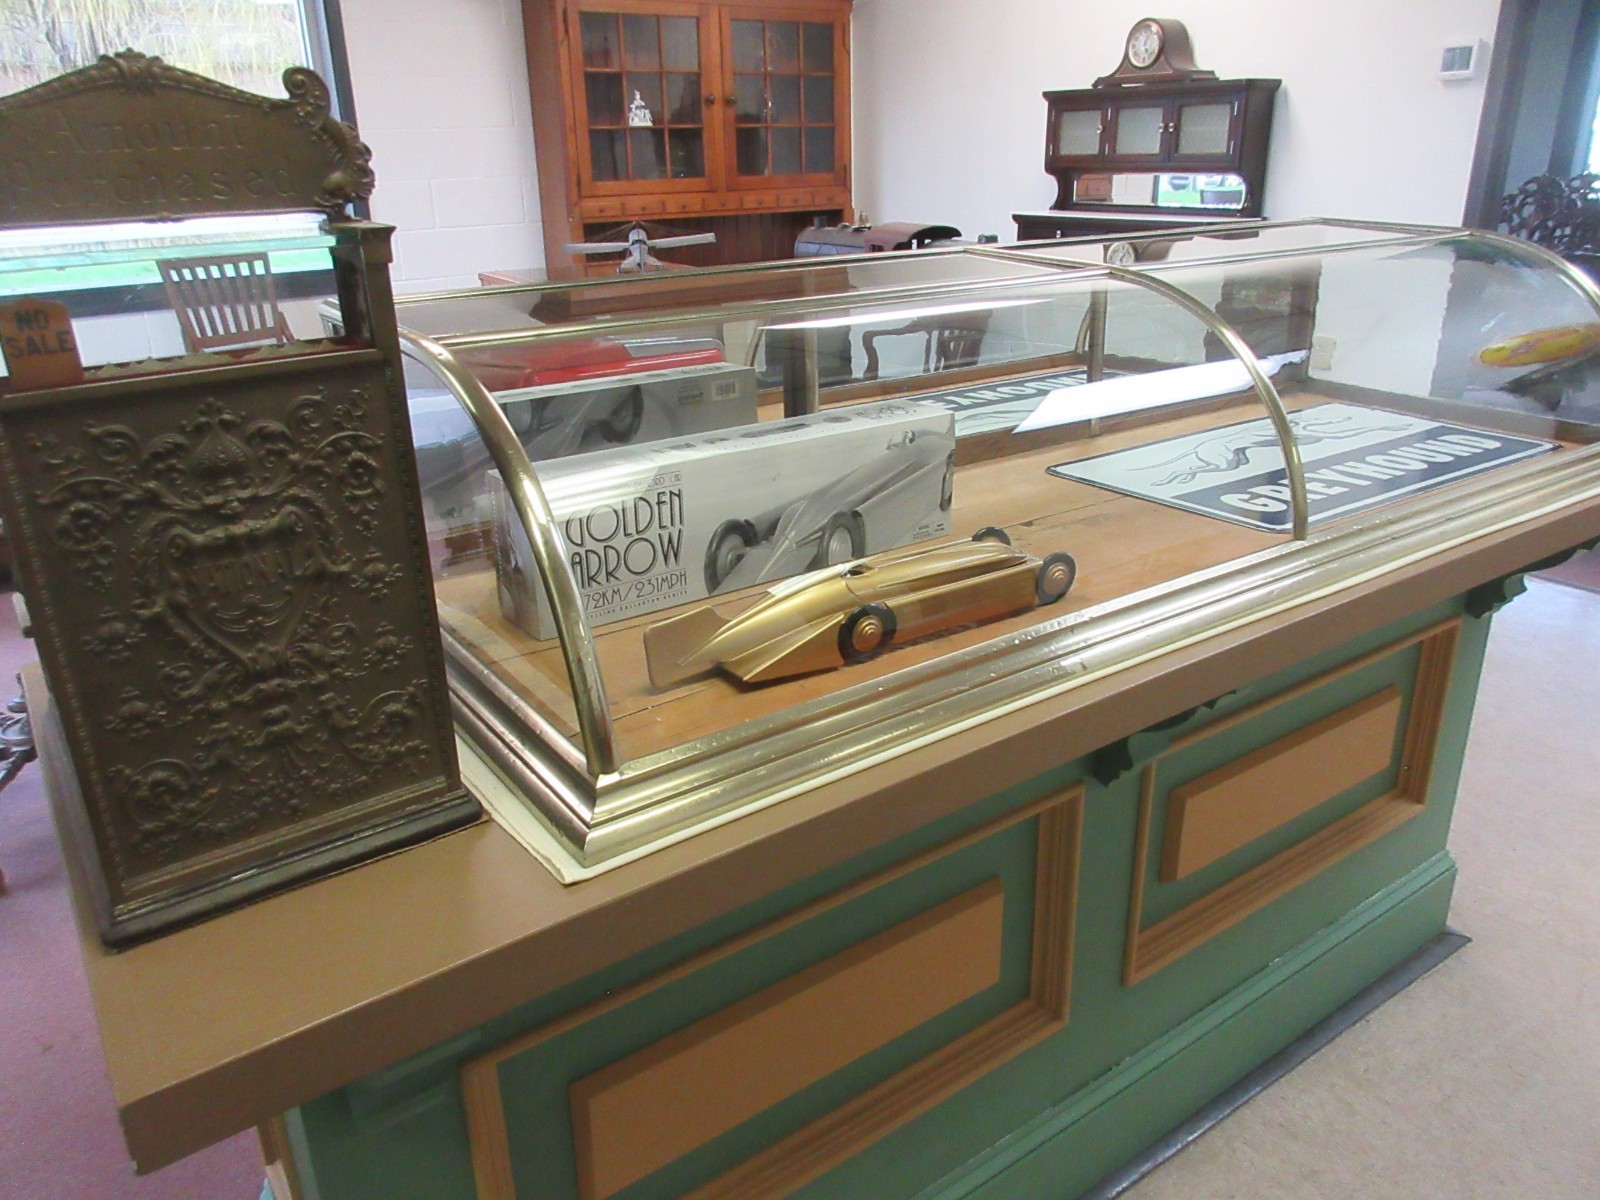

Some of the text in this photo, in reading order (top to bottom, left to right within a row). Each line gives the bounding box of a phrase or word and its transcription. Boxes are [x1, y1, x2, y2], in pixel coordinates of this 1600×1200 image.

[4, 330, 75, 357] SALE
[15, 309, 49, 331] NO
[1220, 434, 1502, 513] GREYHOUND
[565, 488, 684, 548] GOLDEN
[571, 528, 683, 589] ARROW
[583, 570, 687, 611] 72KM/231MPH
